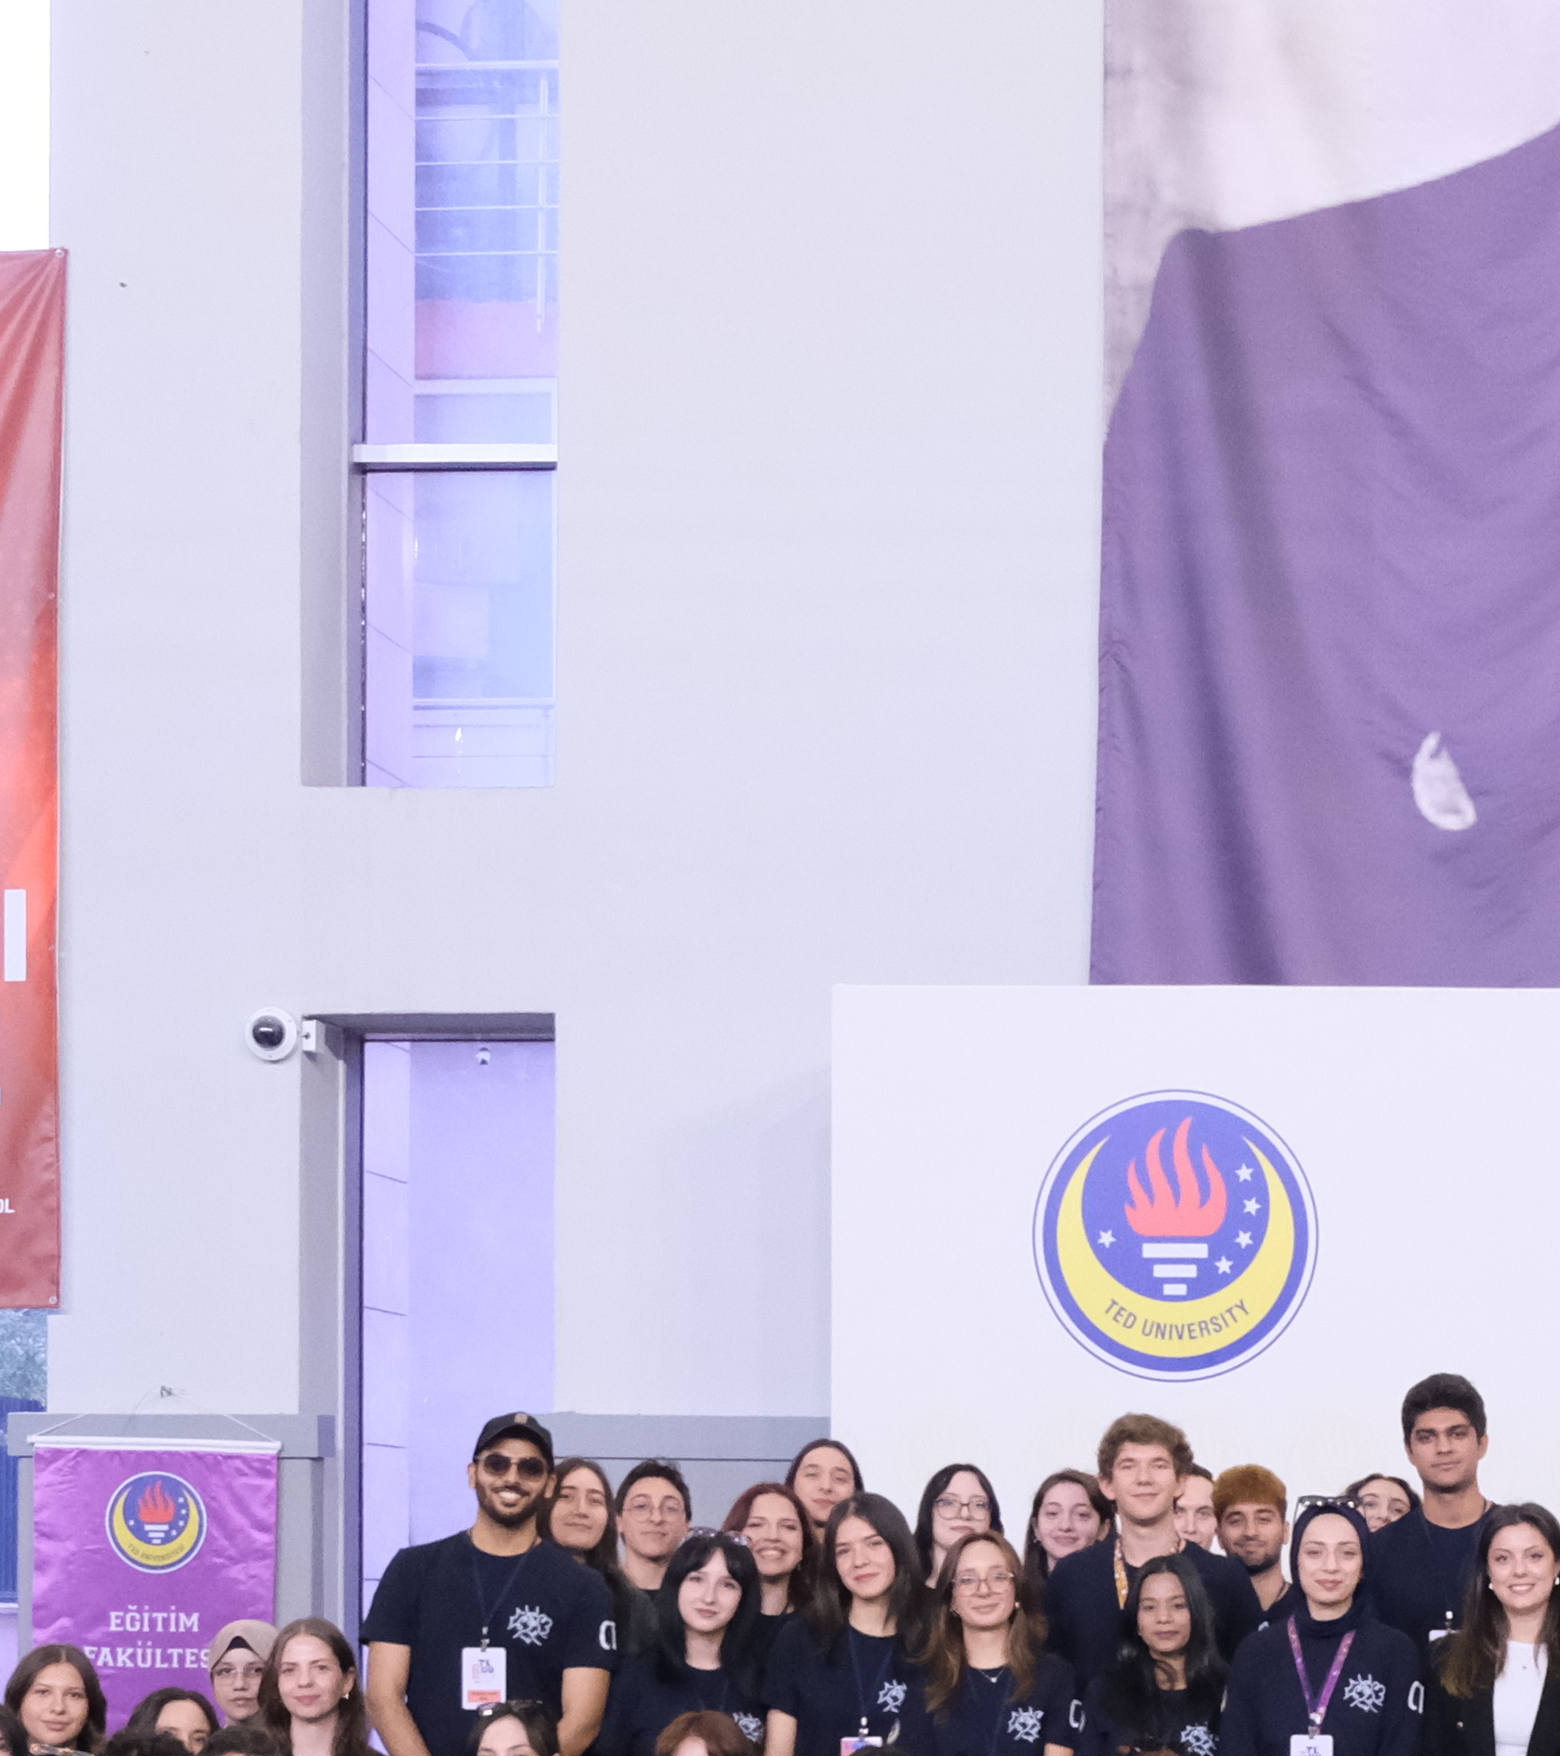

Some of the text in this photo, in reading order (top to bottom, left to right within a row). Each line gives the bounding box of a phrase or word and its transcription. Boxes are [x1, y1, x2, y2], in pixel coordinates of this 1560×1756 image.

[1104, 1298, 1250, 1340] TED UNIVERSITY
[109, 1605, 200, 1633] EĞİTİM
[83, 1640, 210, 1668] FAKÜLTES
